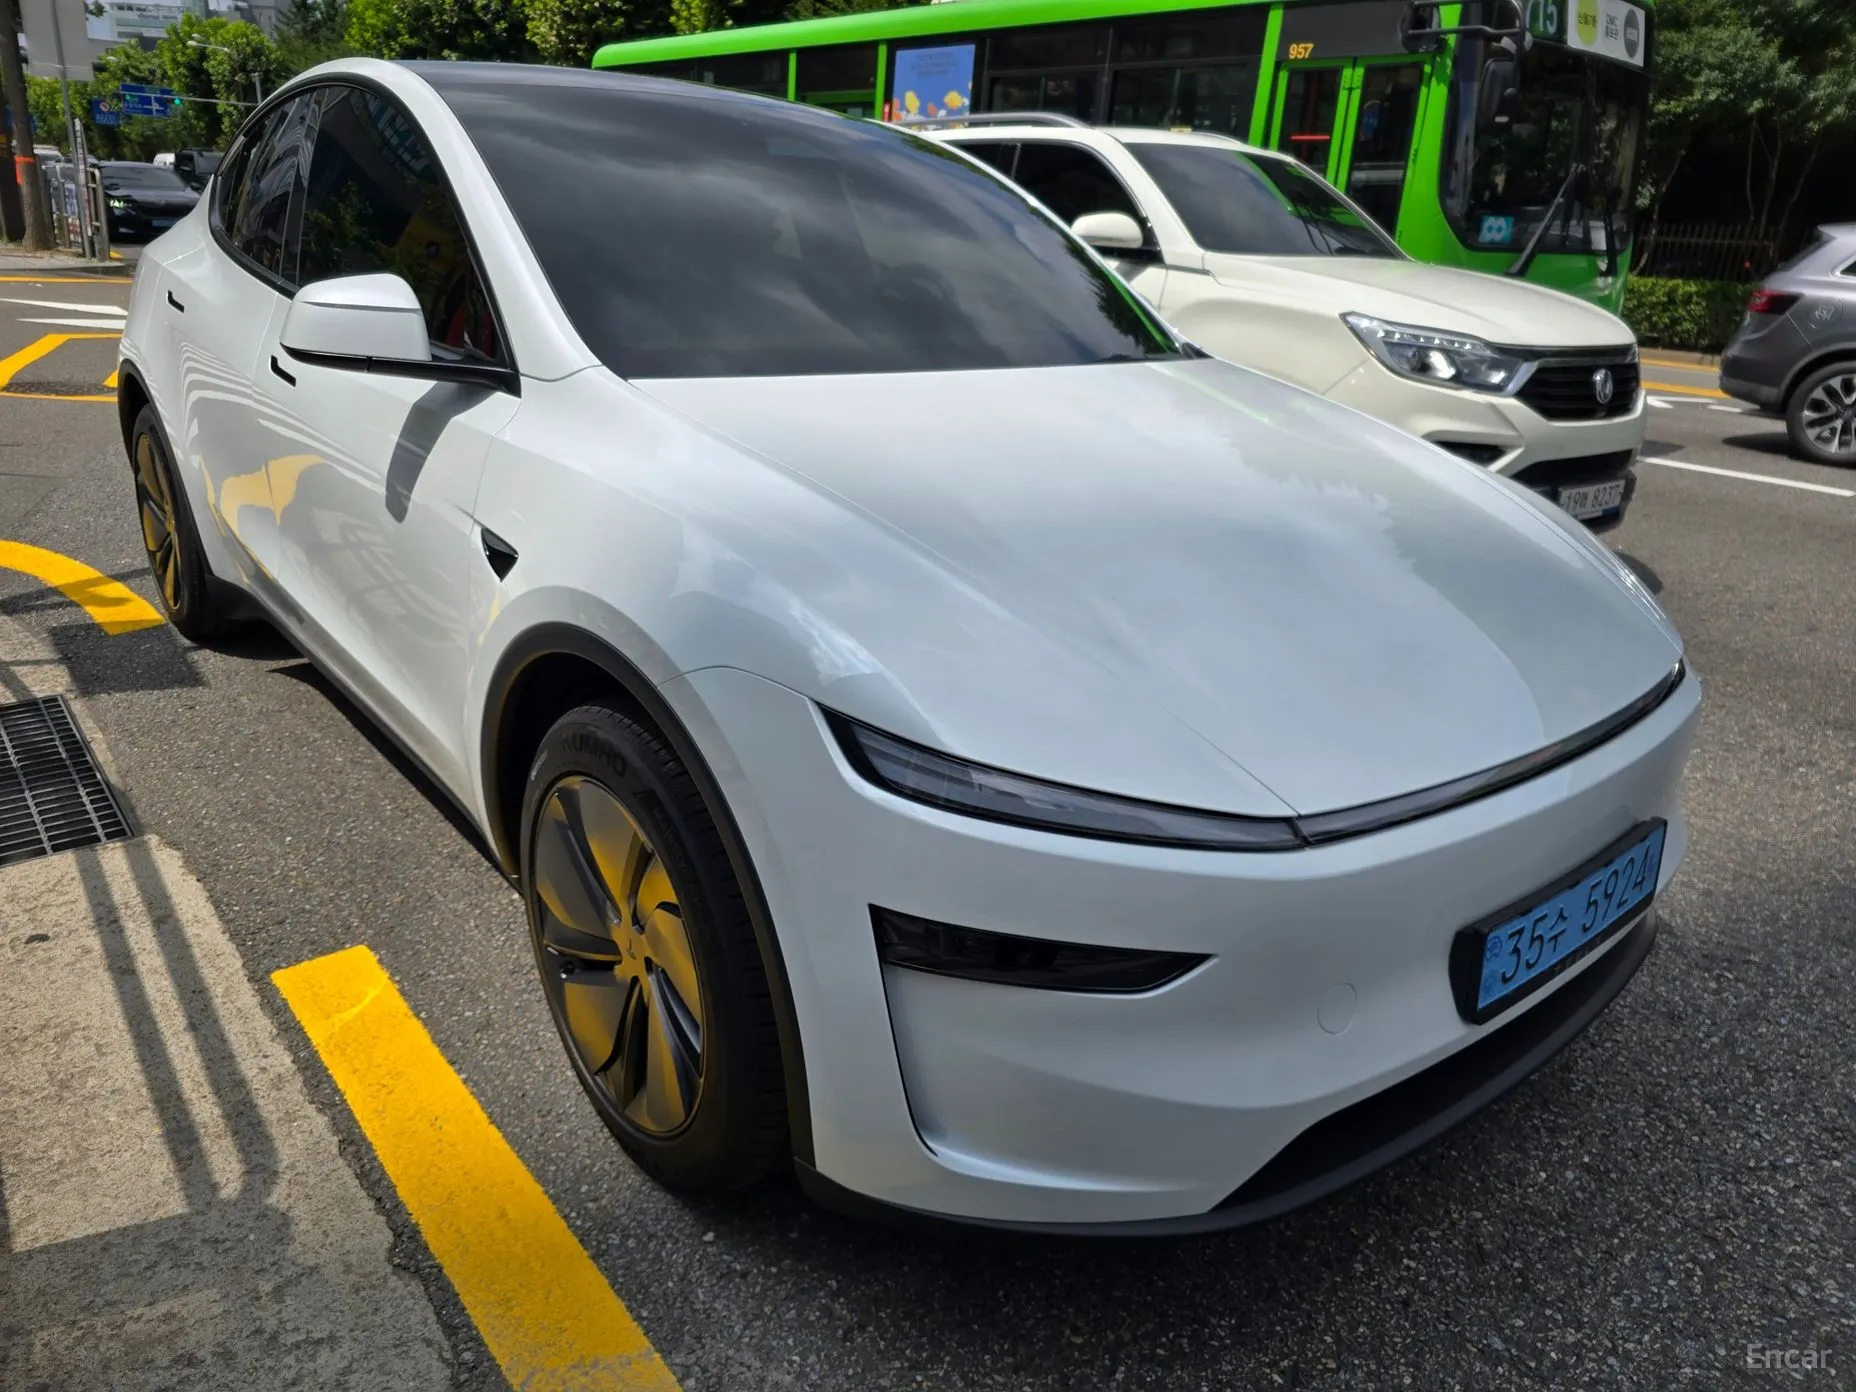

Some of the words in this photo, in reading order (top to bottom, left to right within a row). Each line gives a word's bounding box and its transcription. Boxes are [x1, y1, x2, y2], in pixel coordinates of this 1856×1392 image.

[1289, 43, 1314, 59] 957
[561, 731, 628, 778] KUMHO
[1501, 905, 1568, 985] 35수
[1582, 844, 1650, 934] 5924
